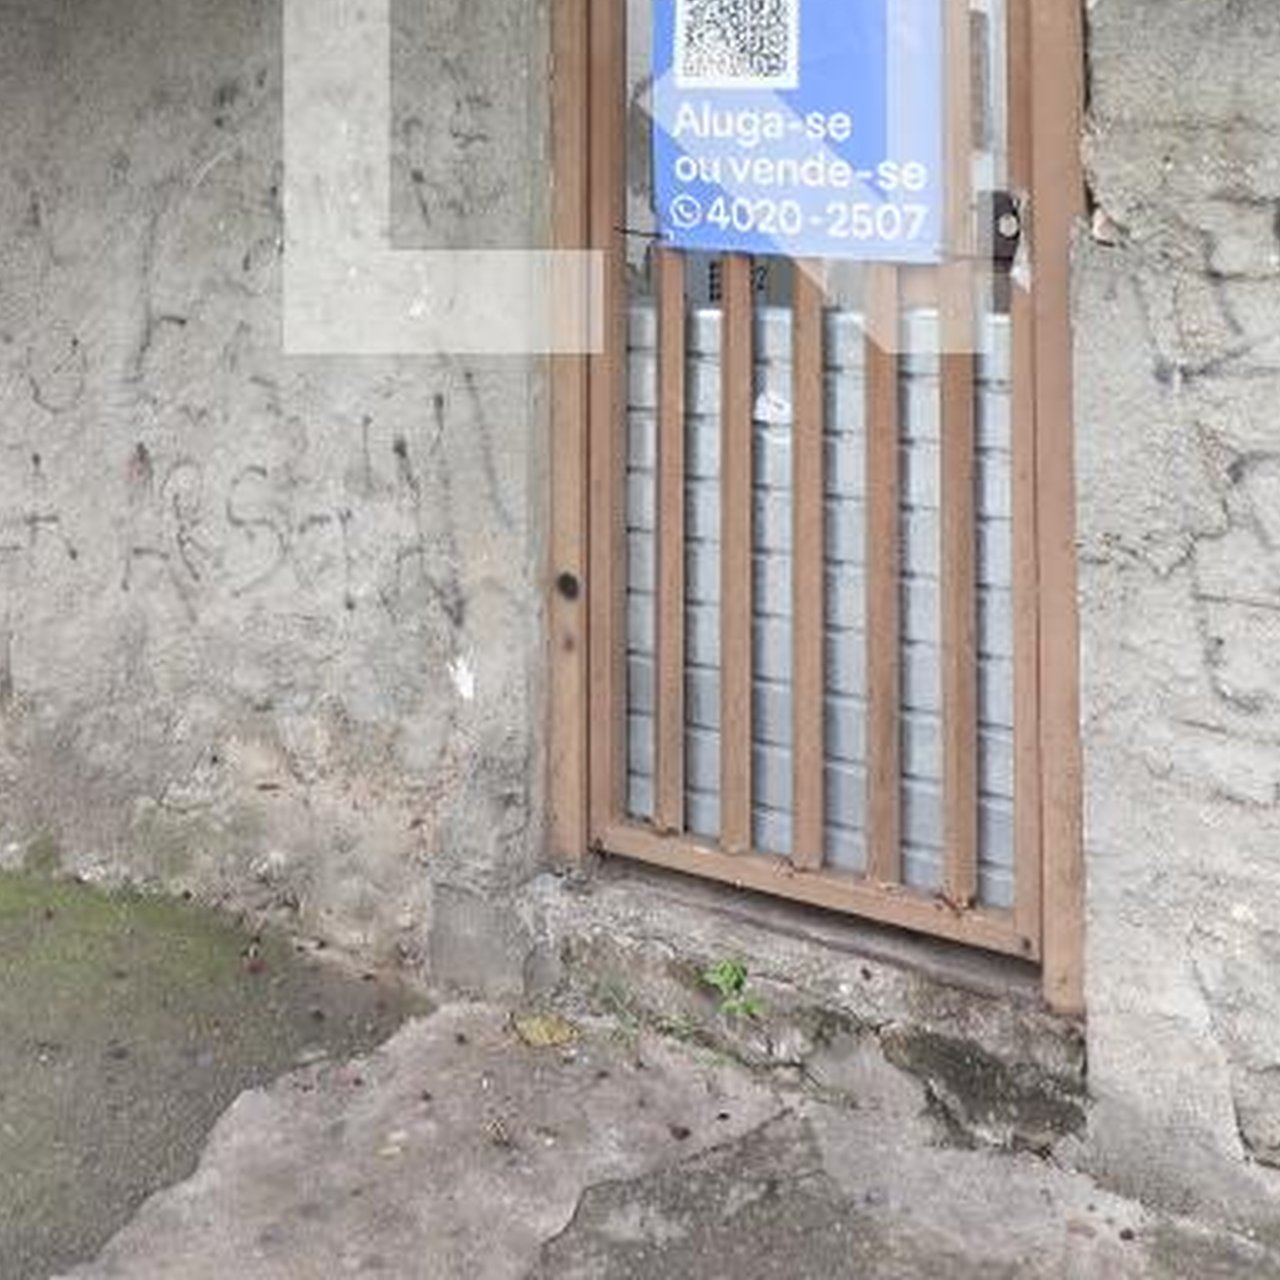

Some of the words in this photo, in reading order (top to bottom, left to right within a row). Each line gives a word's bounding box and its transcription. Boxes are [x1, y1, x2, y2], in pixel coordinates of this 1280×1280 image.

[671, 101, 852, 148] Aluga-se
[675, 156, 721, 184] ou
[729, 151, 927, 192] vende-se
[707, 195, 927, 242] 4020-2507
